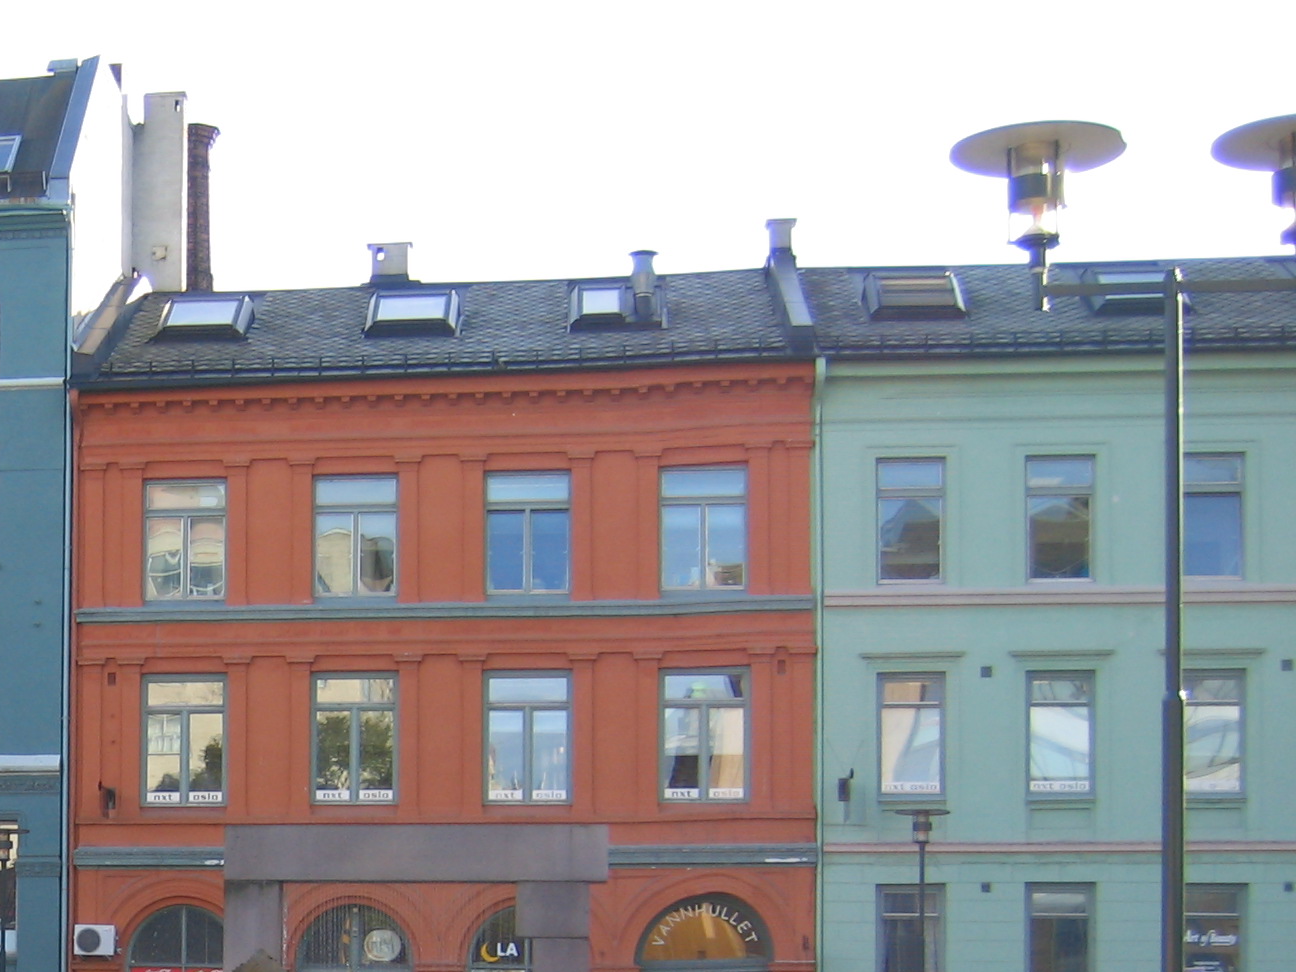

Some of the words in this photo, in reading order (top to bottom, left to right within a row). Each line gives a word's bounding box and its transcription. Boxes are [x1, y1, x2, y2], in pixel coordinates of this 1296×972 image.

[153, 793, 172, 801] nxt
[193, 792, 218, 801] oslo
[364, 791, 389, 799] oslo
[652, 904, 759, 947] VANNHULLET
[497, 943, 518, 957] LA
